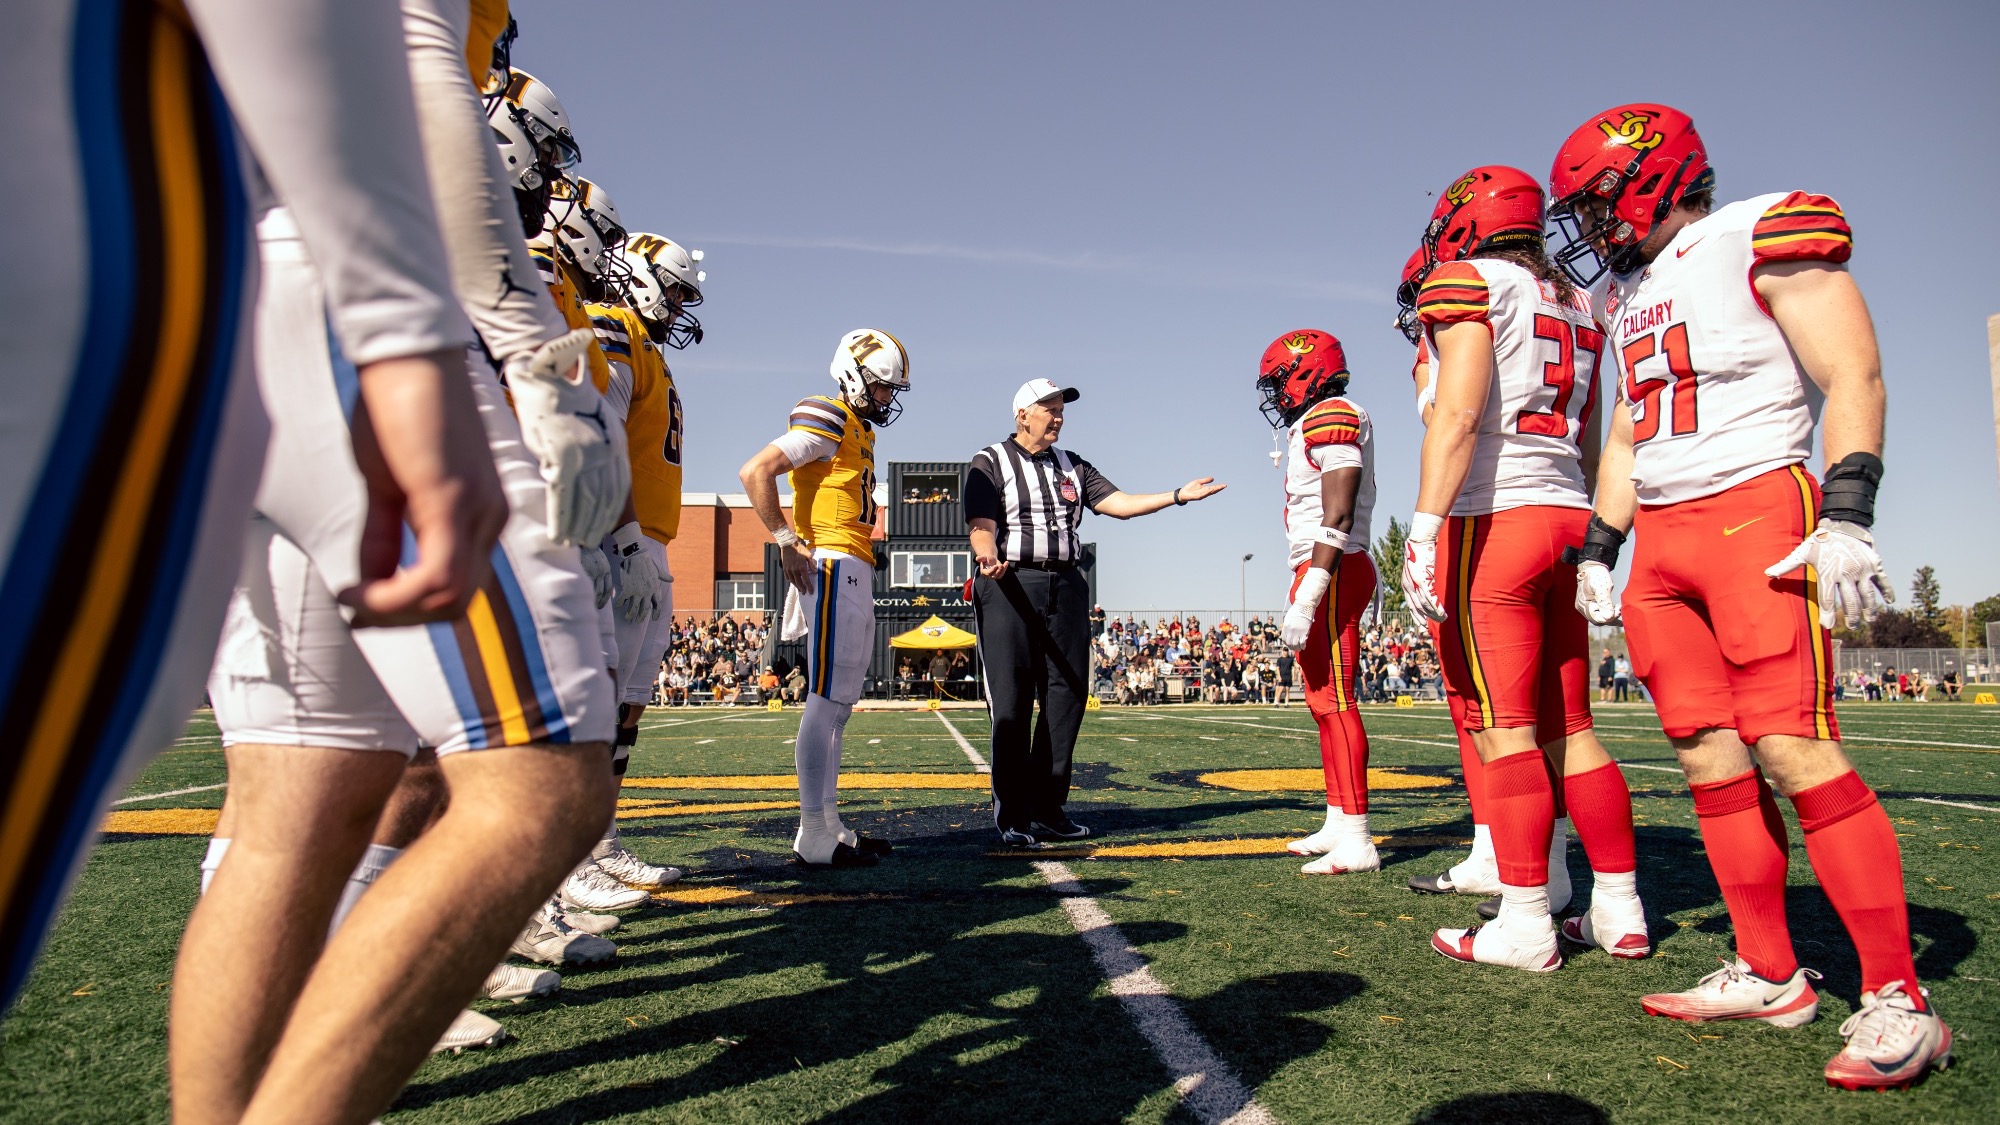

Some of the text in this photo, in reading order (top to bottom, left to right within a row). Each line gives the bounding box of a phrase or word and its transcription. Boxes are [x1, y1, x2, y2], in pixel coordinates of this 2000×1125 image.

[1598, 111, 1664, 151] UC
[627, 234, 669, 263] M
[1493, 234, 1531, 242] UNIVERSITY
[1623, 299, 1672, 338] CALGARY
[848, 333, 883, 365] M
[1282, 333, 1315, 354] UC
[1516, 313, 1606, 446] 37
[1622, 321, 1698, 445] 51
[663, 386, 683, 465] 6
[874, 598, 972, 606] KOTA LAN
[770, 702, 781, 710] 50
[1088, 700, 1099, 708] 50
[1401, 698, 1412, 706] 40
